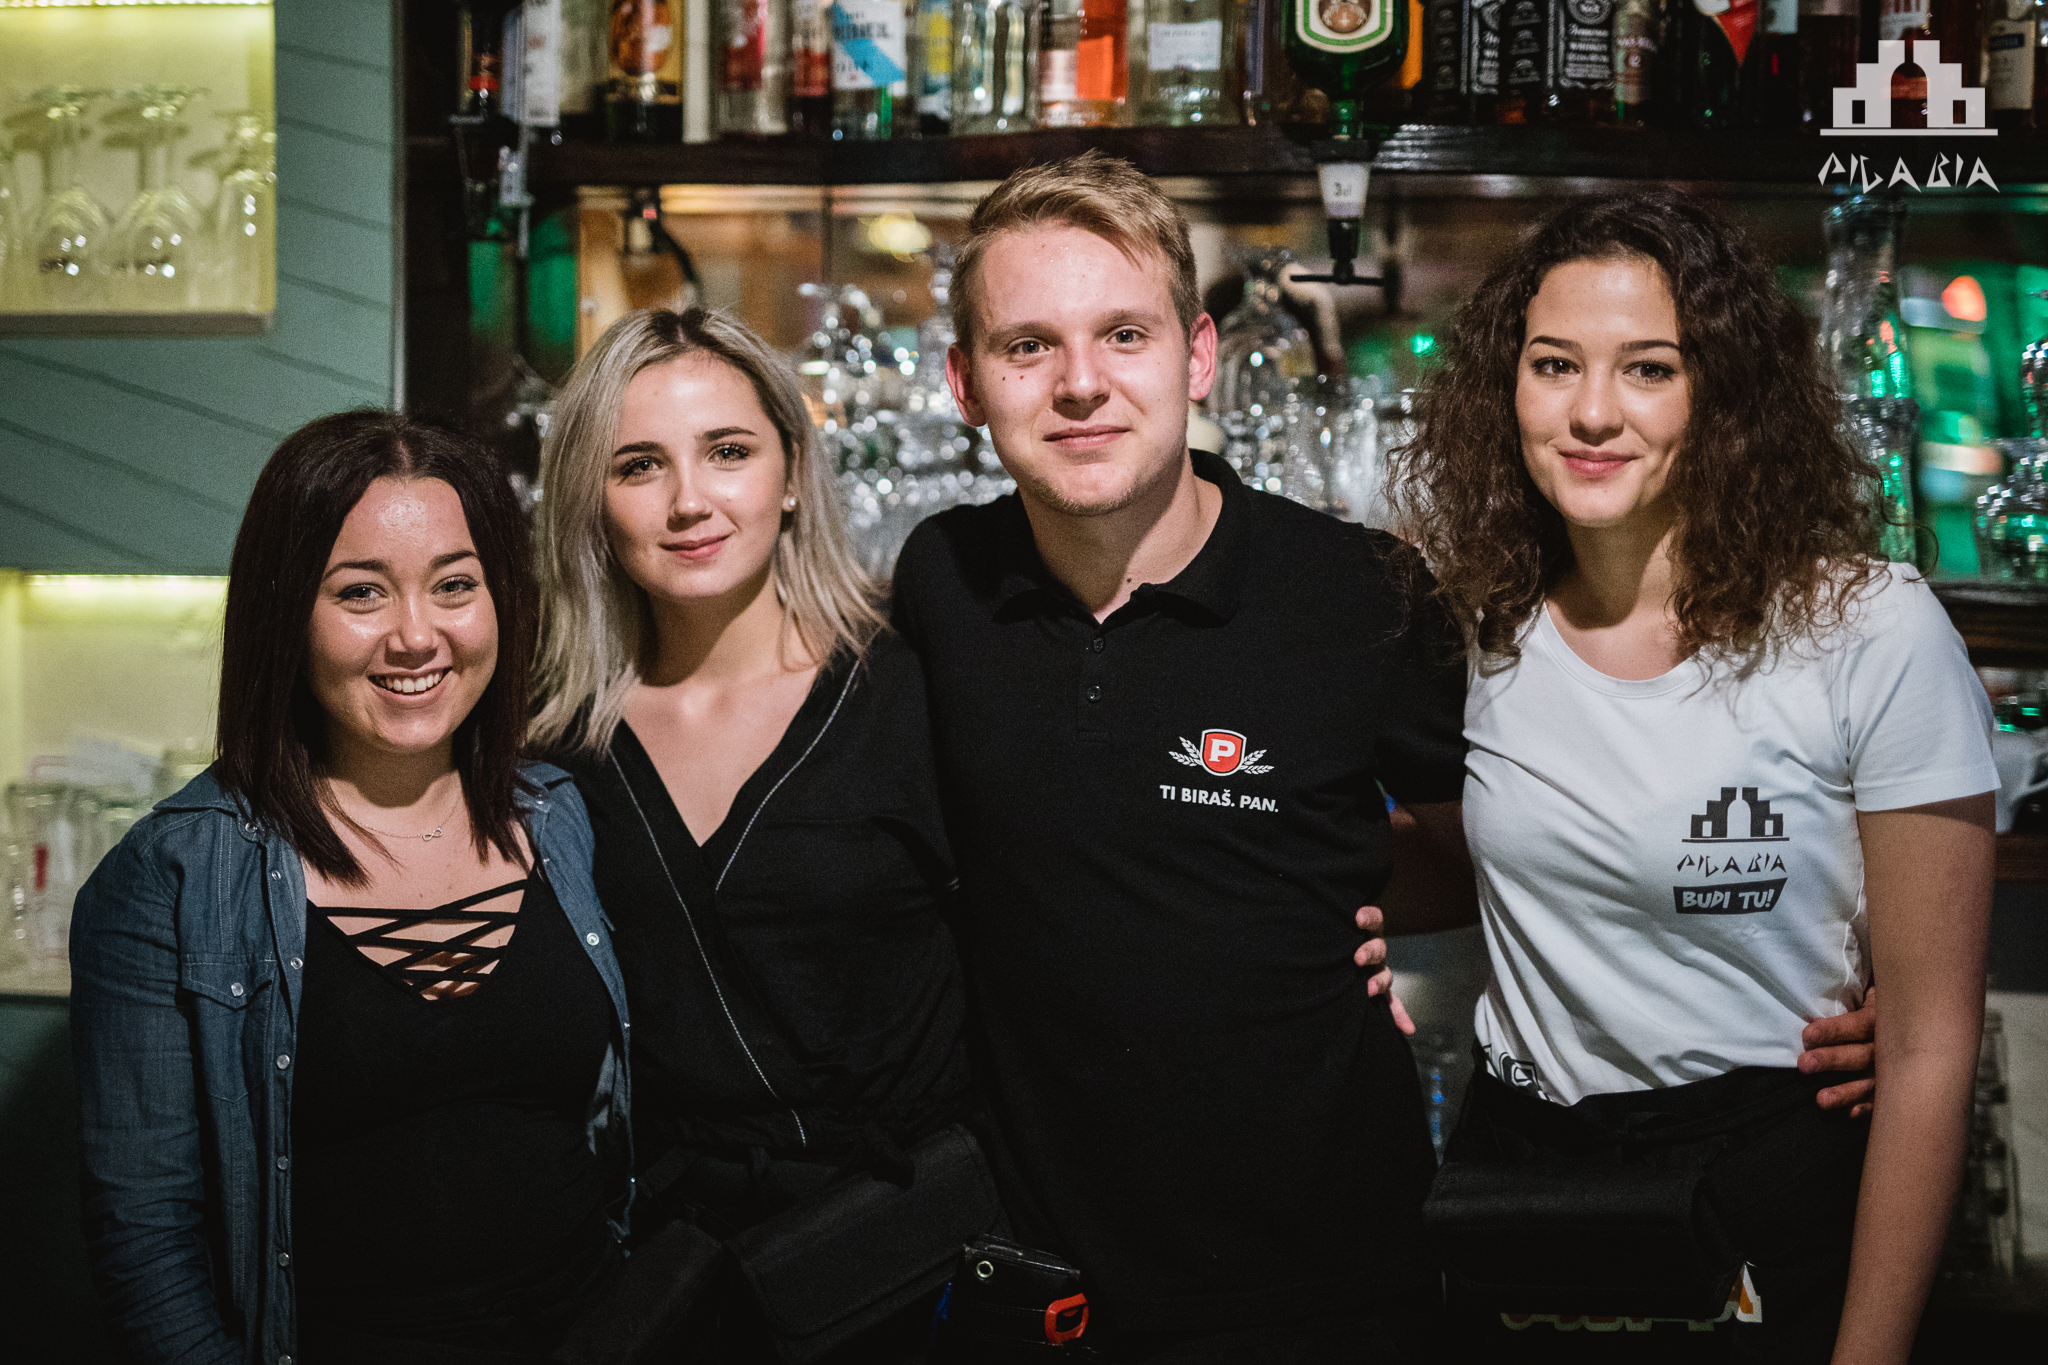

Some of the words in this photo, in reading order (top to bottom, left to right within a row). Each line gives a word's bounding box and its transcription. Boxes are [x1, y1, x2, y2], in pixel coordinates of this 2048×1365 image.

[1209, 738, 1236, 762] P
[1160, 785, 1176, 800] TI
[1181, 788, 1235, 807] BIRAŠ.
[1240, 795, 1279, 813] PAN.
[1682, 890, 1731, 909] BUDI
[1738, 888, 1775, 909] TU!
